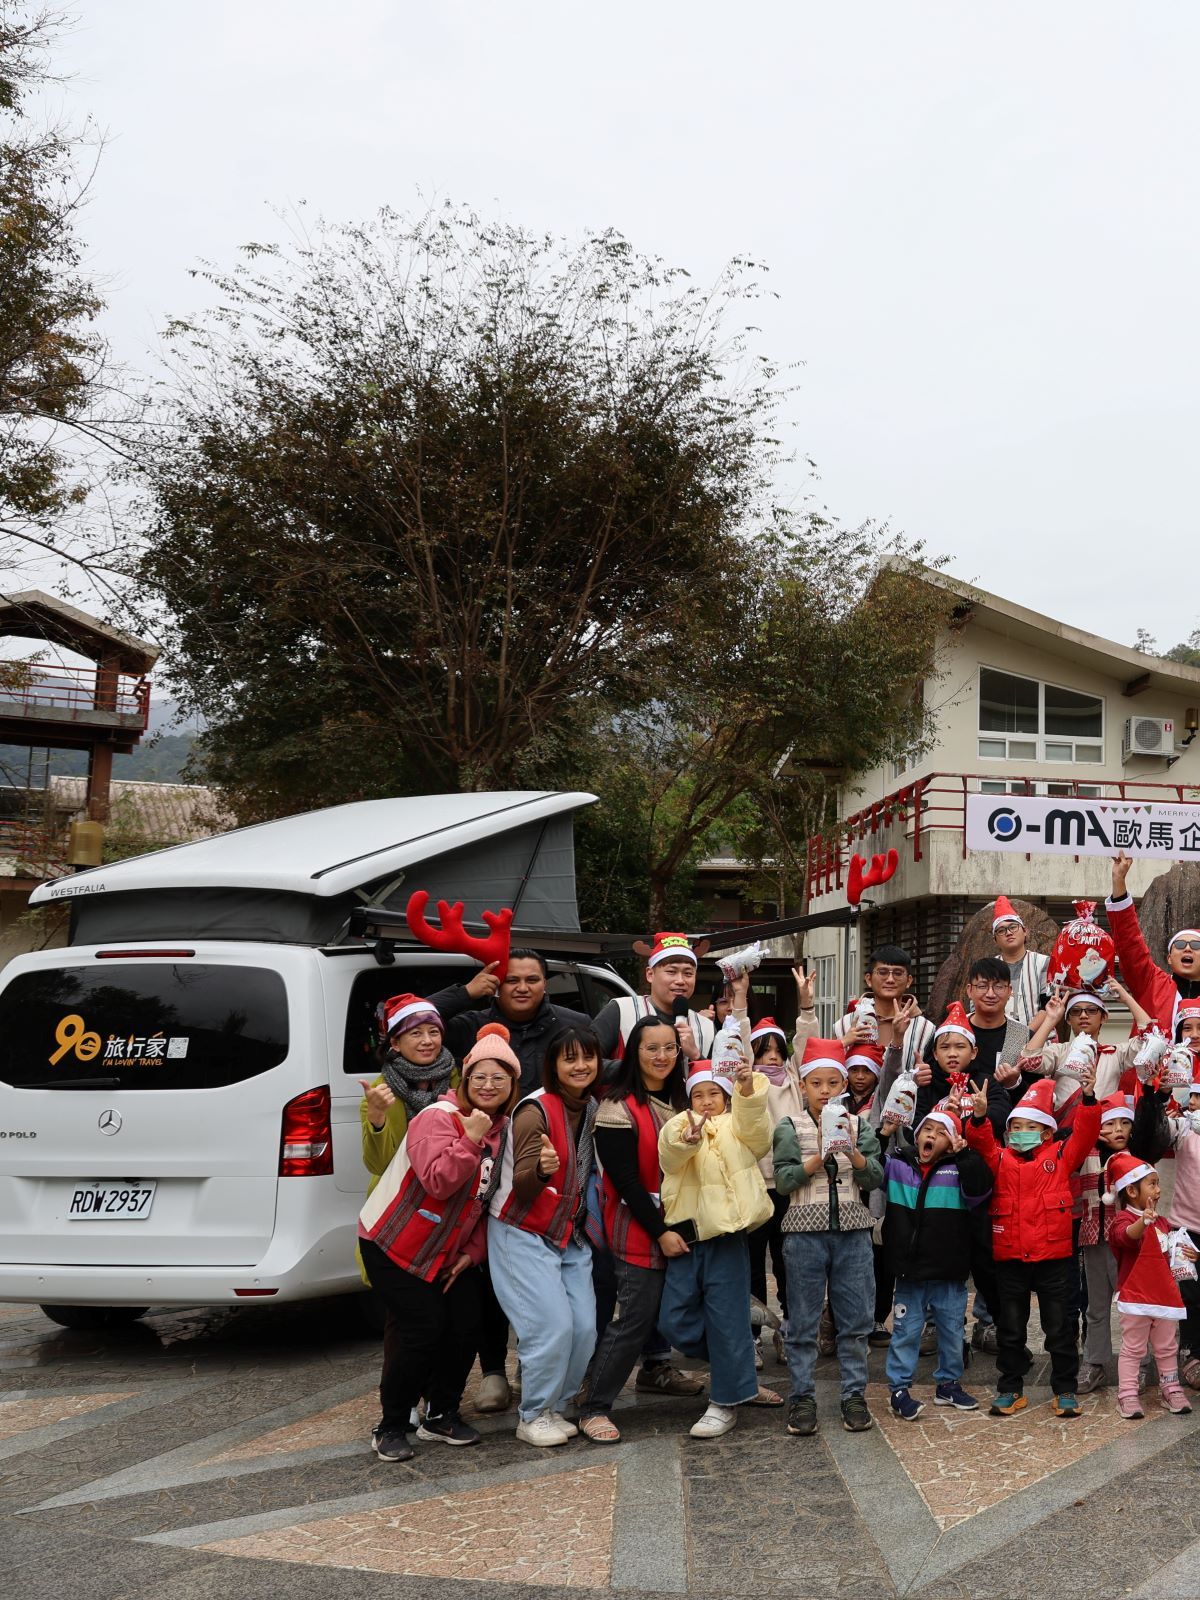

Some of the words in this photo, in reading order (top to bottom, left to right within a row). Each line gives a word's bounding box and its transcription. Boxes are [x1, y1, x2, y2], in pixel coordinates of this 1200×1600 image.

[1158, 809, 1190, 818] MERRY
[50, 883, 106, 897] WESTFALIA
[1080, 936, 1102, 946] PARTY
[104, 1031, 167, 1058] 旅行家
[9, 1131, 37, 1139] POLO
